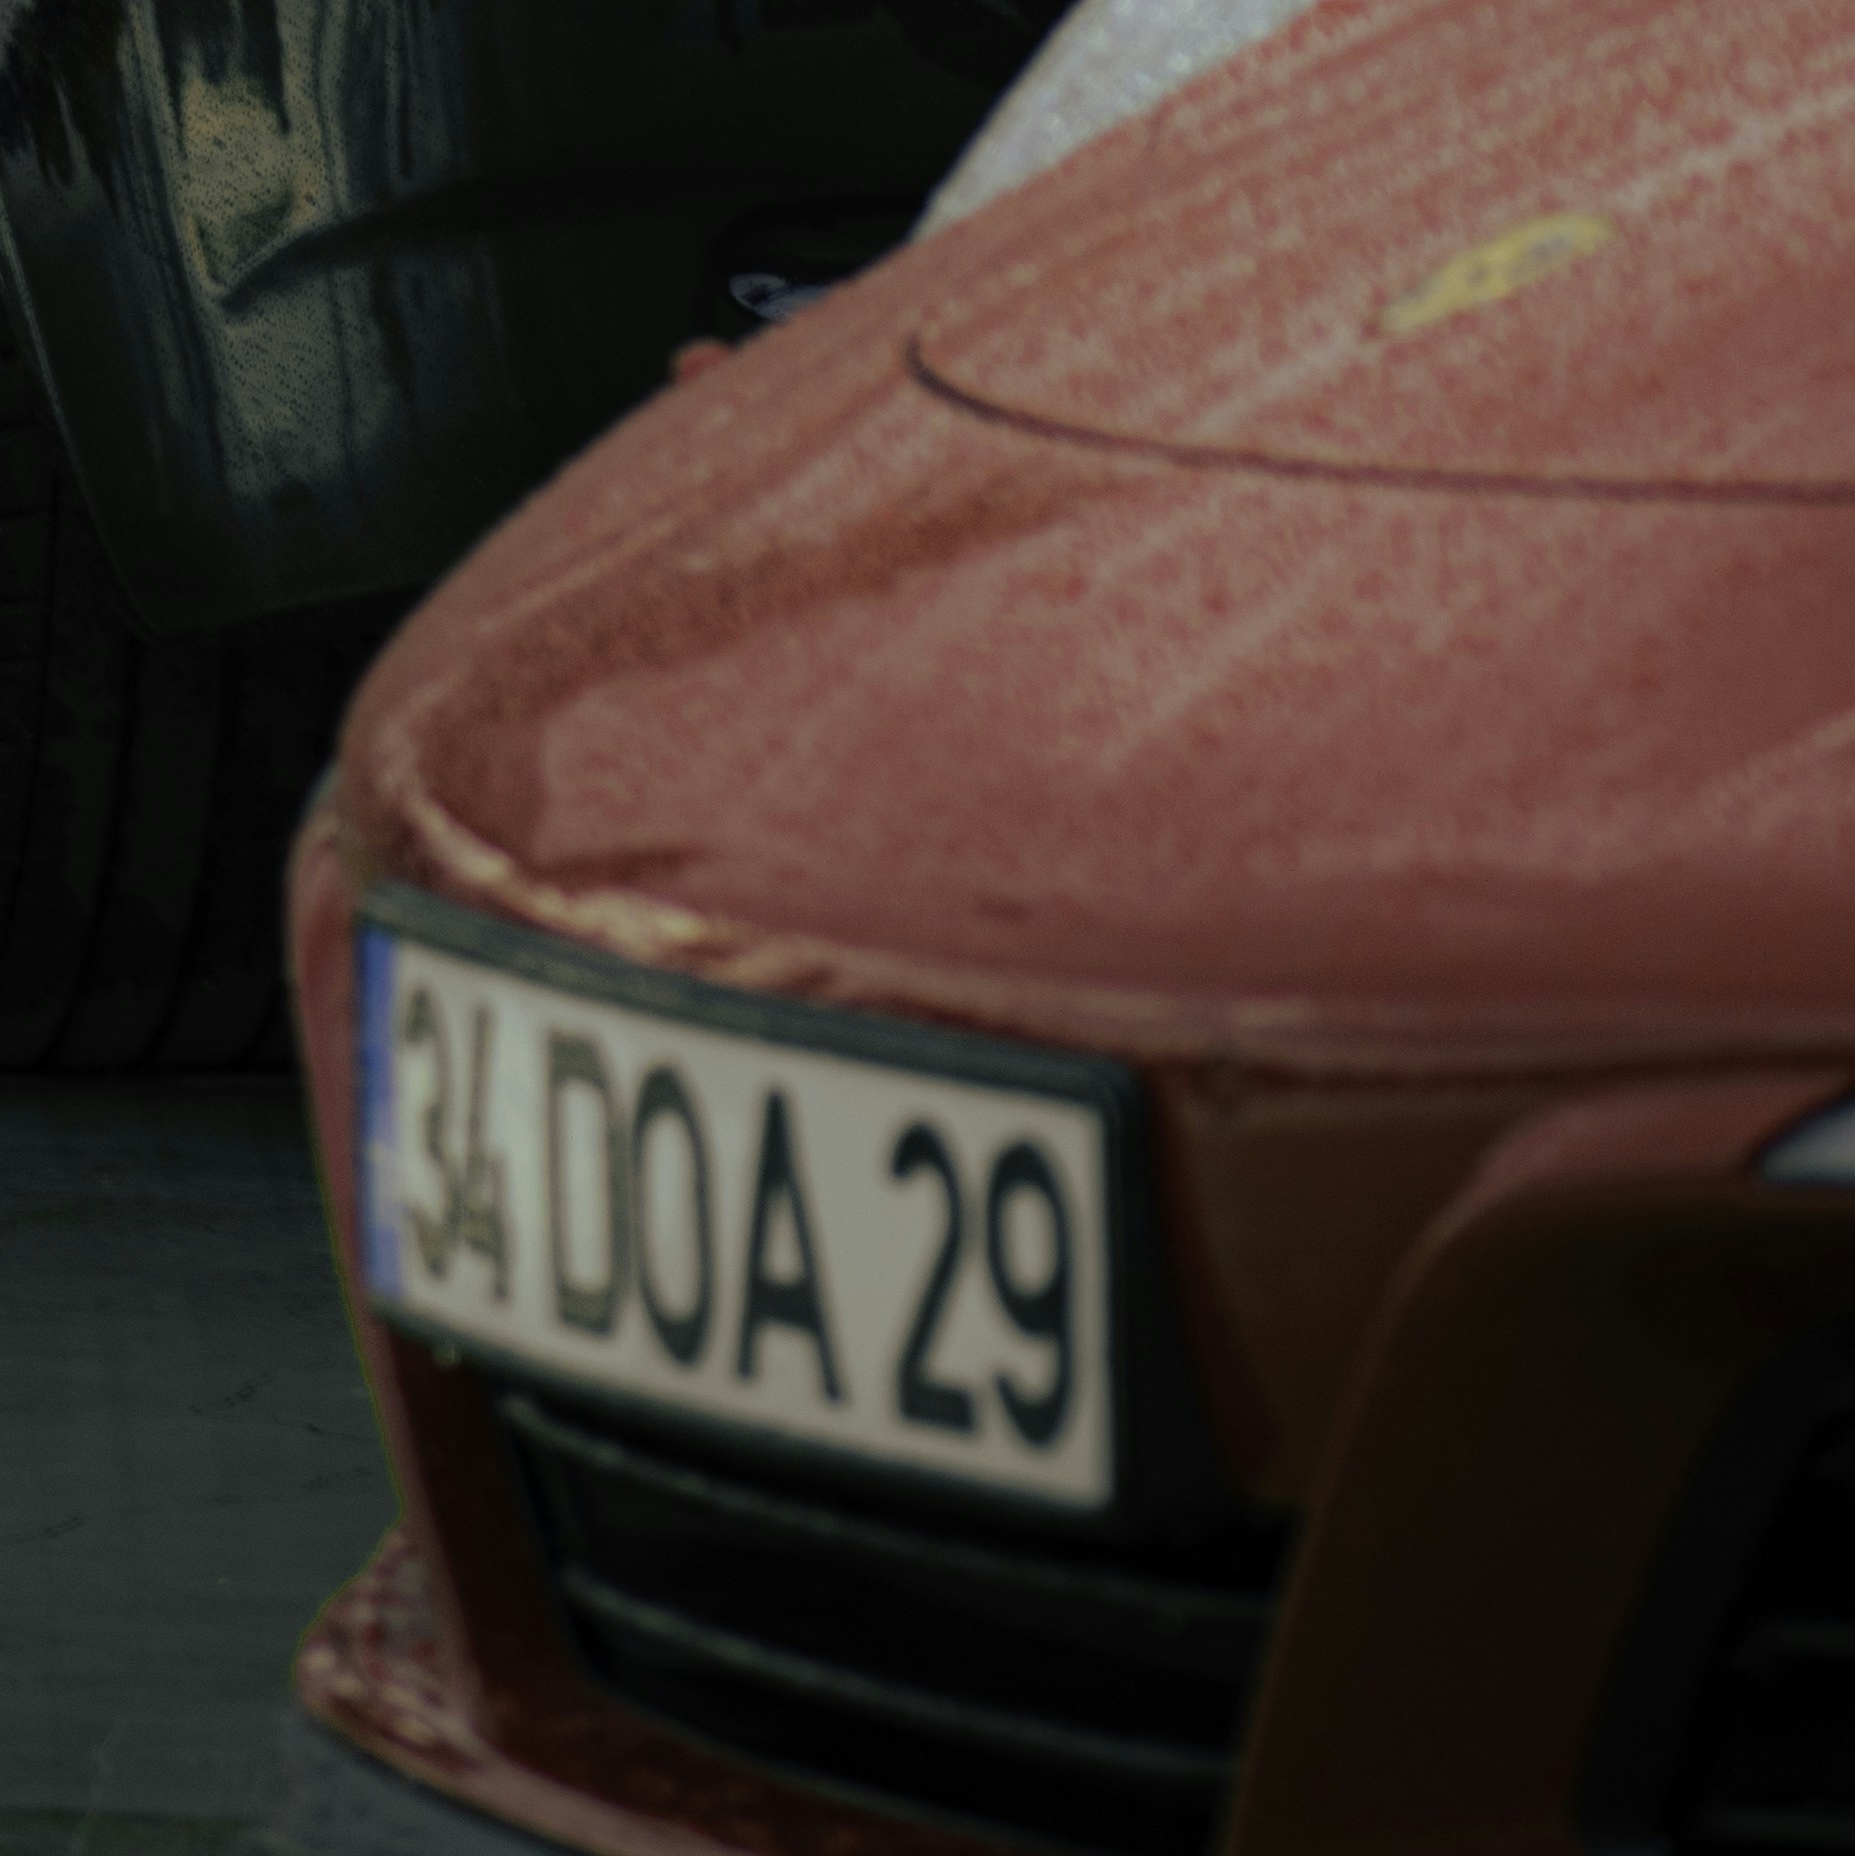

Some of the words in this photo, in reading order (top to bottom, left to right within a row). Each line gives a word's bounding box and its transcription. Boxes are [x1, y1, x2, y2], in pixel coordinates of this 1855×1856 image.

[402, 984, 508, 1305] 34
[546, 1025, 846, 1406] DOA
[890, 1119, 1078, 1447] 29
